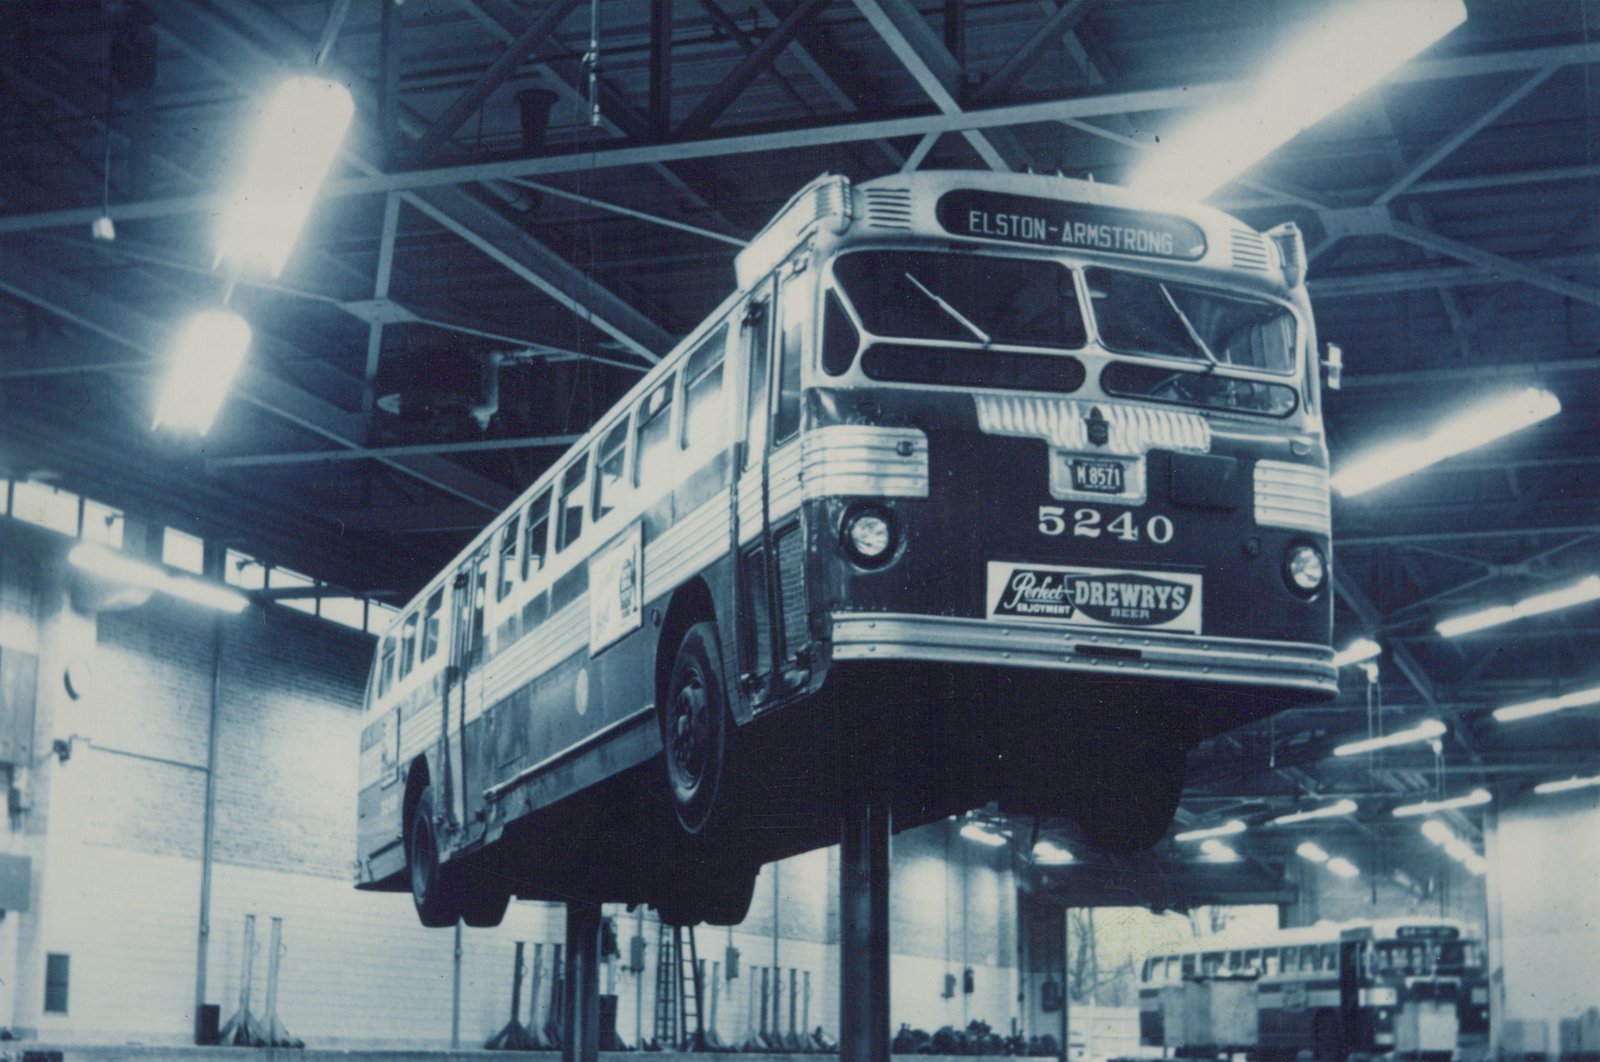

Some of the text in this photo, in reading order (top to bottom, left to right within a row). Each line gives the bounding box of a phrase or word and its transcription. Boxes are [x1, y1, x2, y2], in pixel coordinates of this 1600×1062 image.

[968, 210, 1174, 255] ELSTON-ARMSTRONG
[1089, 466, 1121, 487] 8571
[1038, 505, 1174, 544] 5240
[1003, 572, 1074, 610] Perfect
[1075, 580, 1186, 611] DREWRYS
[1016, 602, 1071, 615] ENJOYMENT
[1110, 608, 1150, 619] BEER
